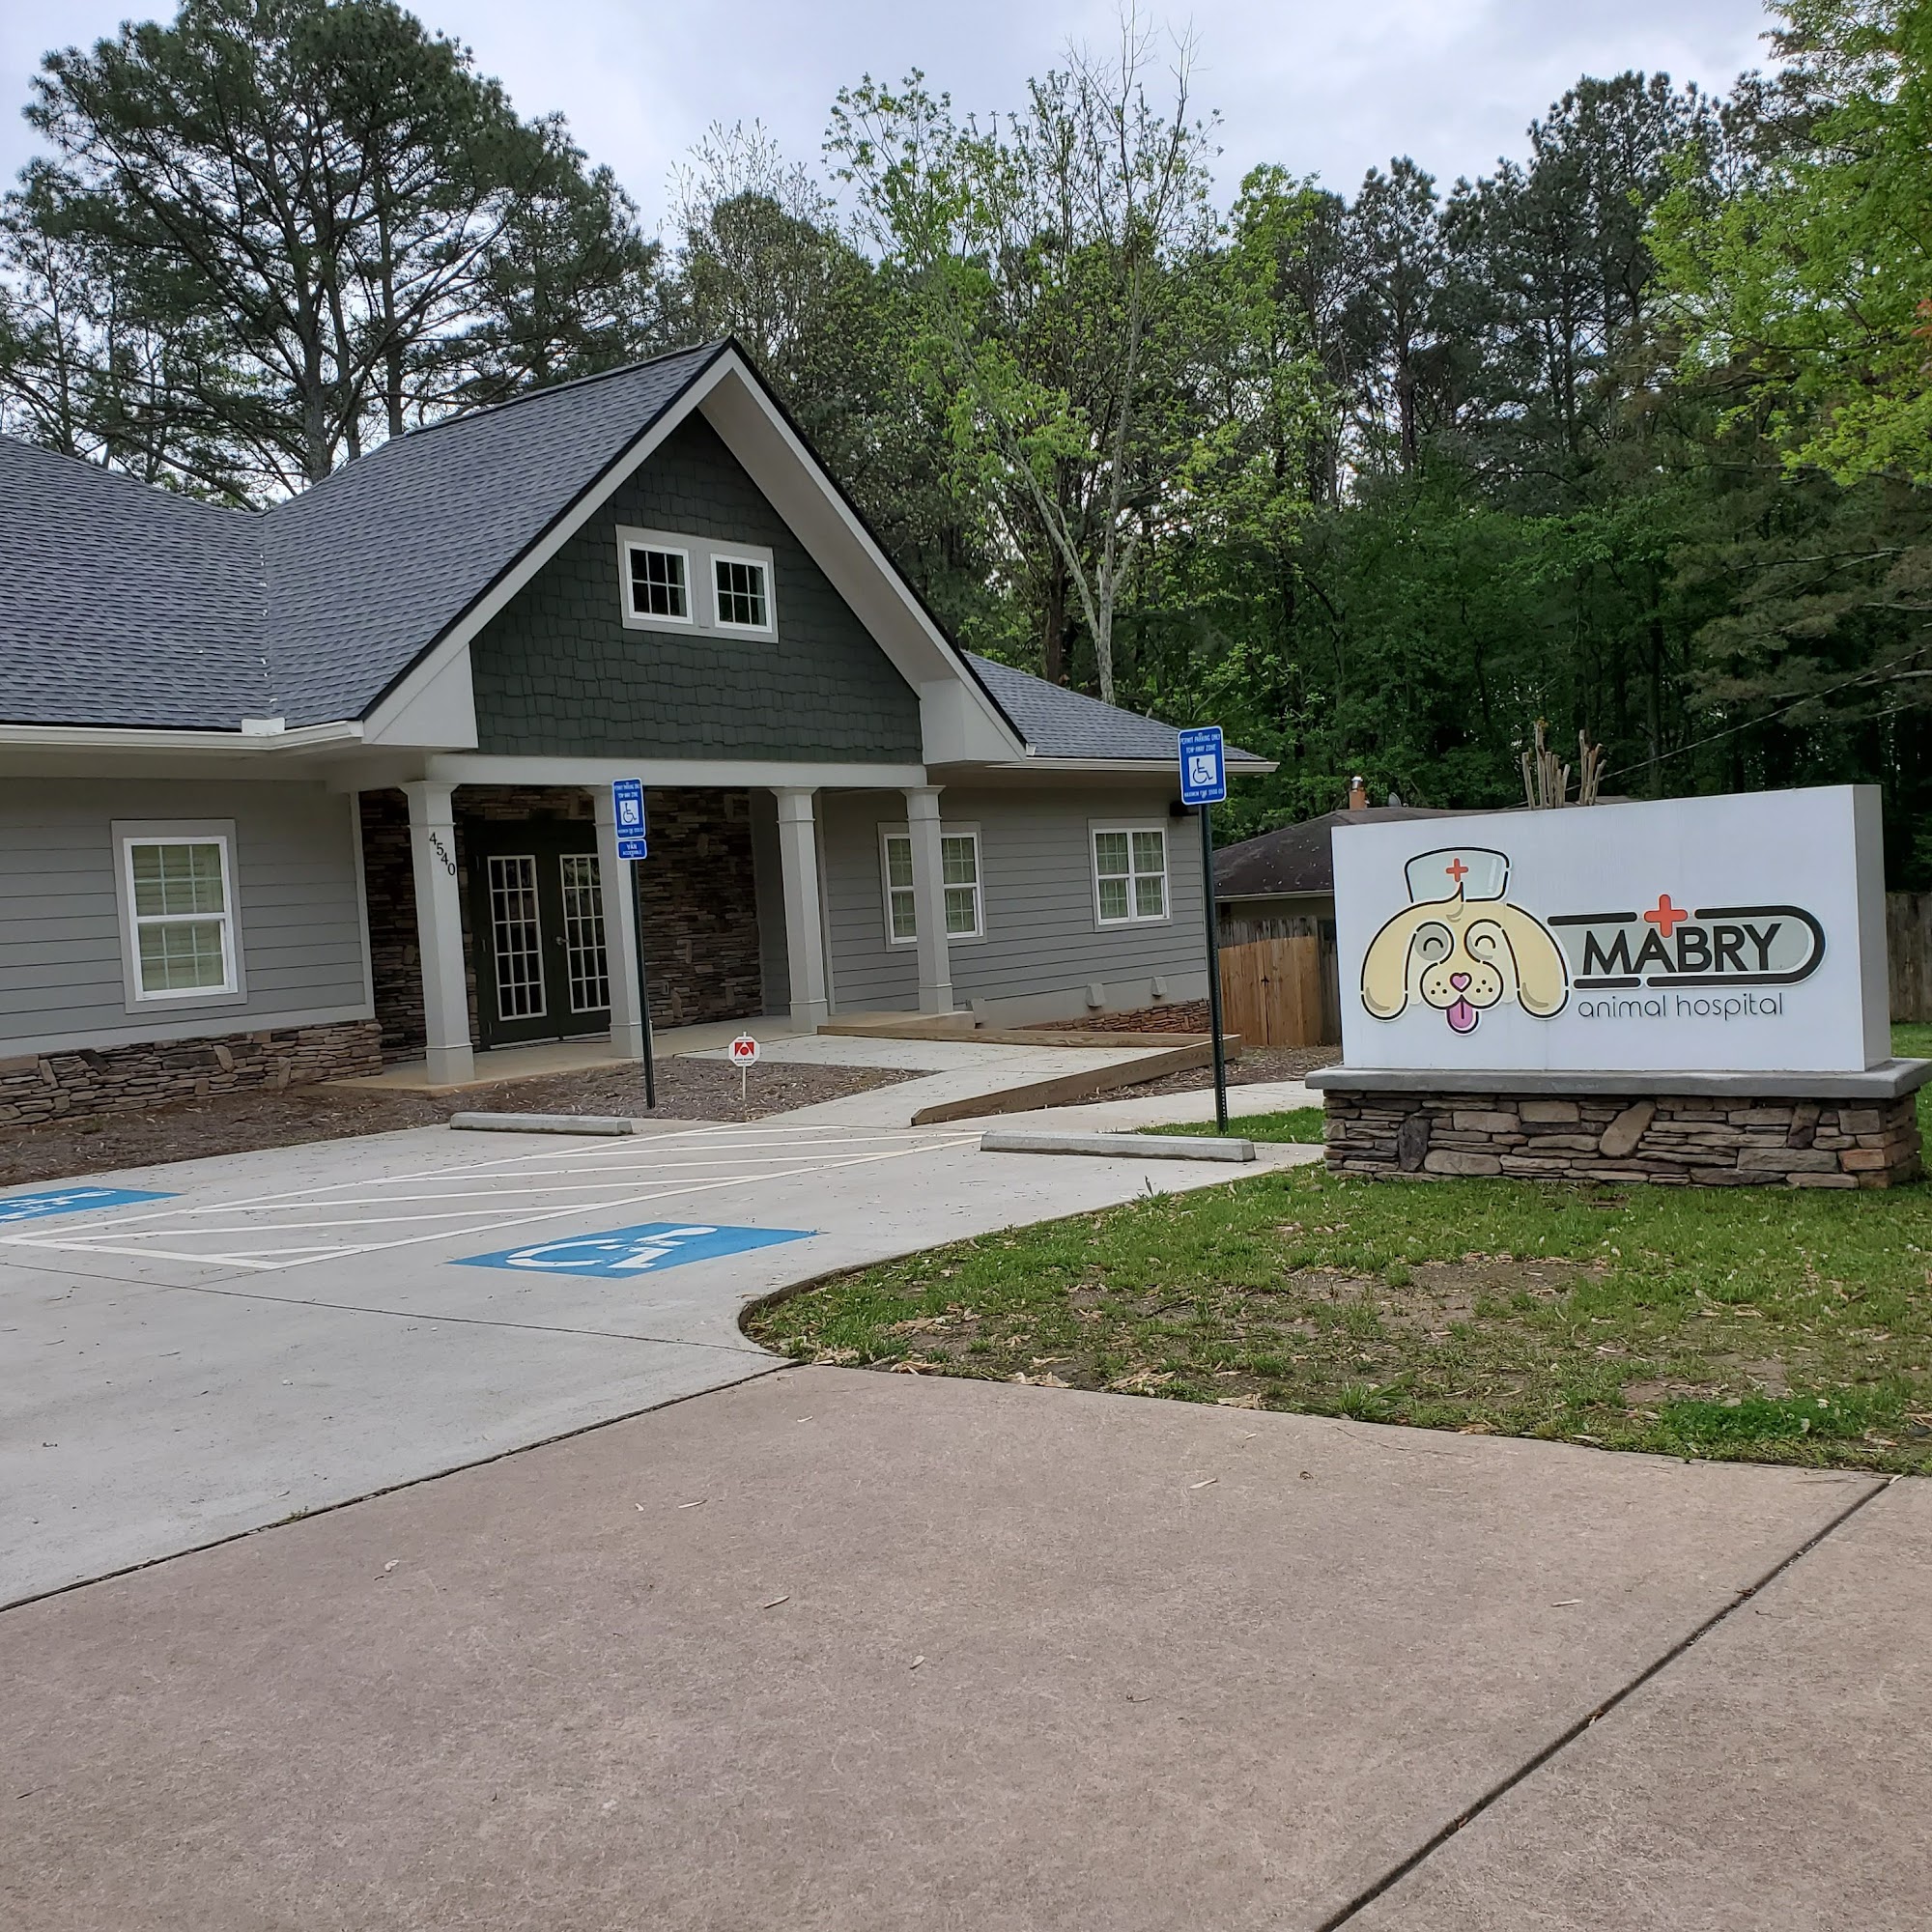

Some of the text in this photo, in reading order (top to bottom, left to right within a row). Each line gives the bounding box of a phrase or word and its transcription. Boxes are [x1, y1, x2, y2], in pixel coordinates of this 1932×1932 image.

[429, 832, 456, 876] 4540
[1582, 923, 1782, 976] MABRY
[1577, 992, 1783, 1021] animal hospital
